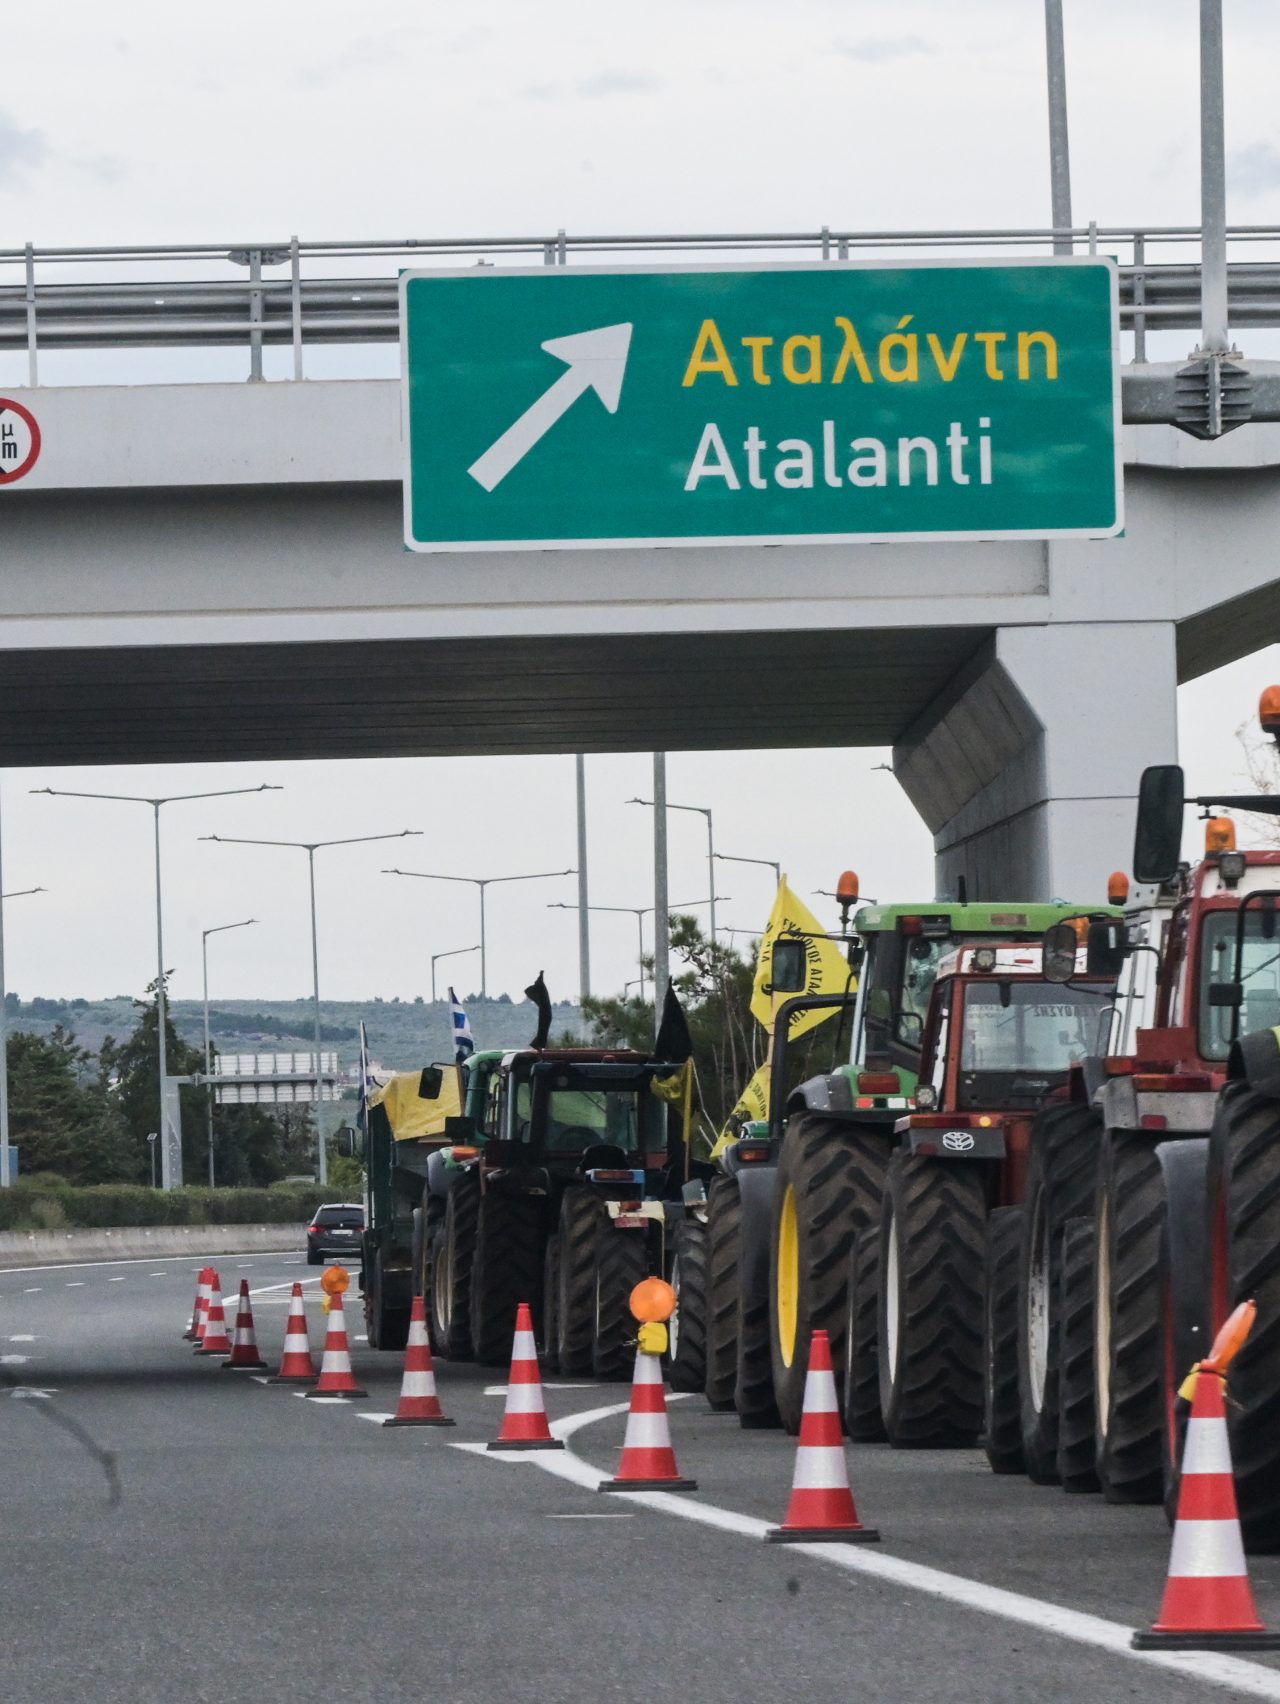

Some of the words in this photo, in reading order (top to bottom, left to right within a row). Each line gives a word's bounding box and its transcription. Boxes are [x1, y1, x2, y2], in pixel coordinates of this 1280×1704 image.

[681, 314, 1059, 387] Αταλάντη
[2, 442, 17, 459] m
[683, 416, 993, 491] Atalanti
